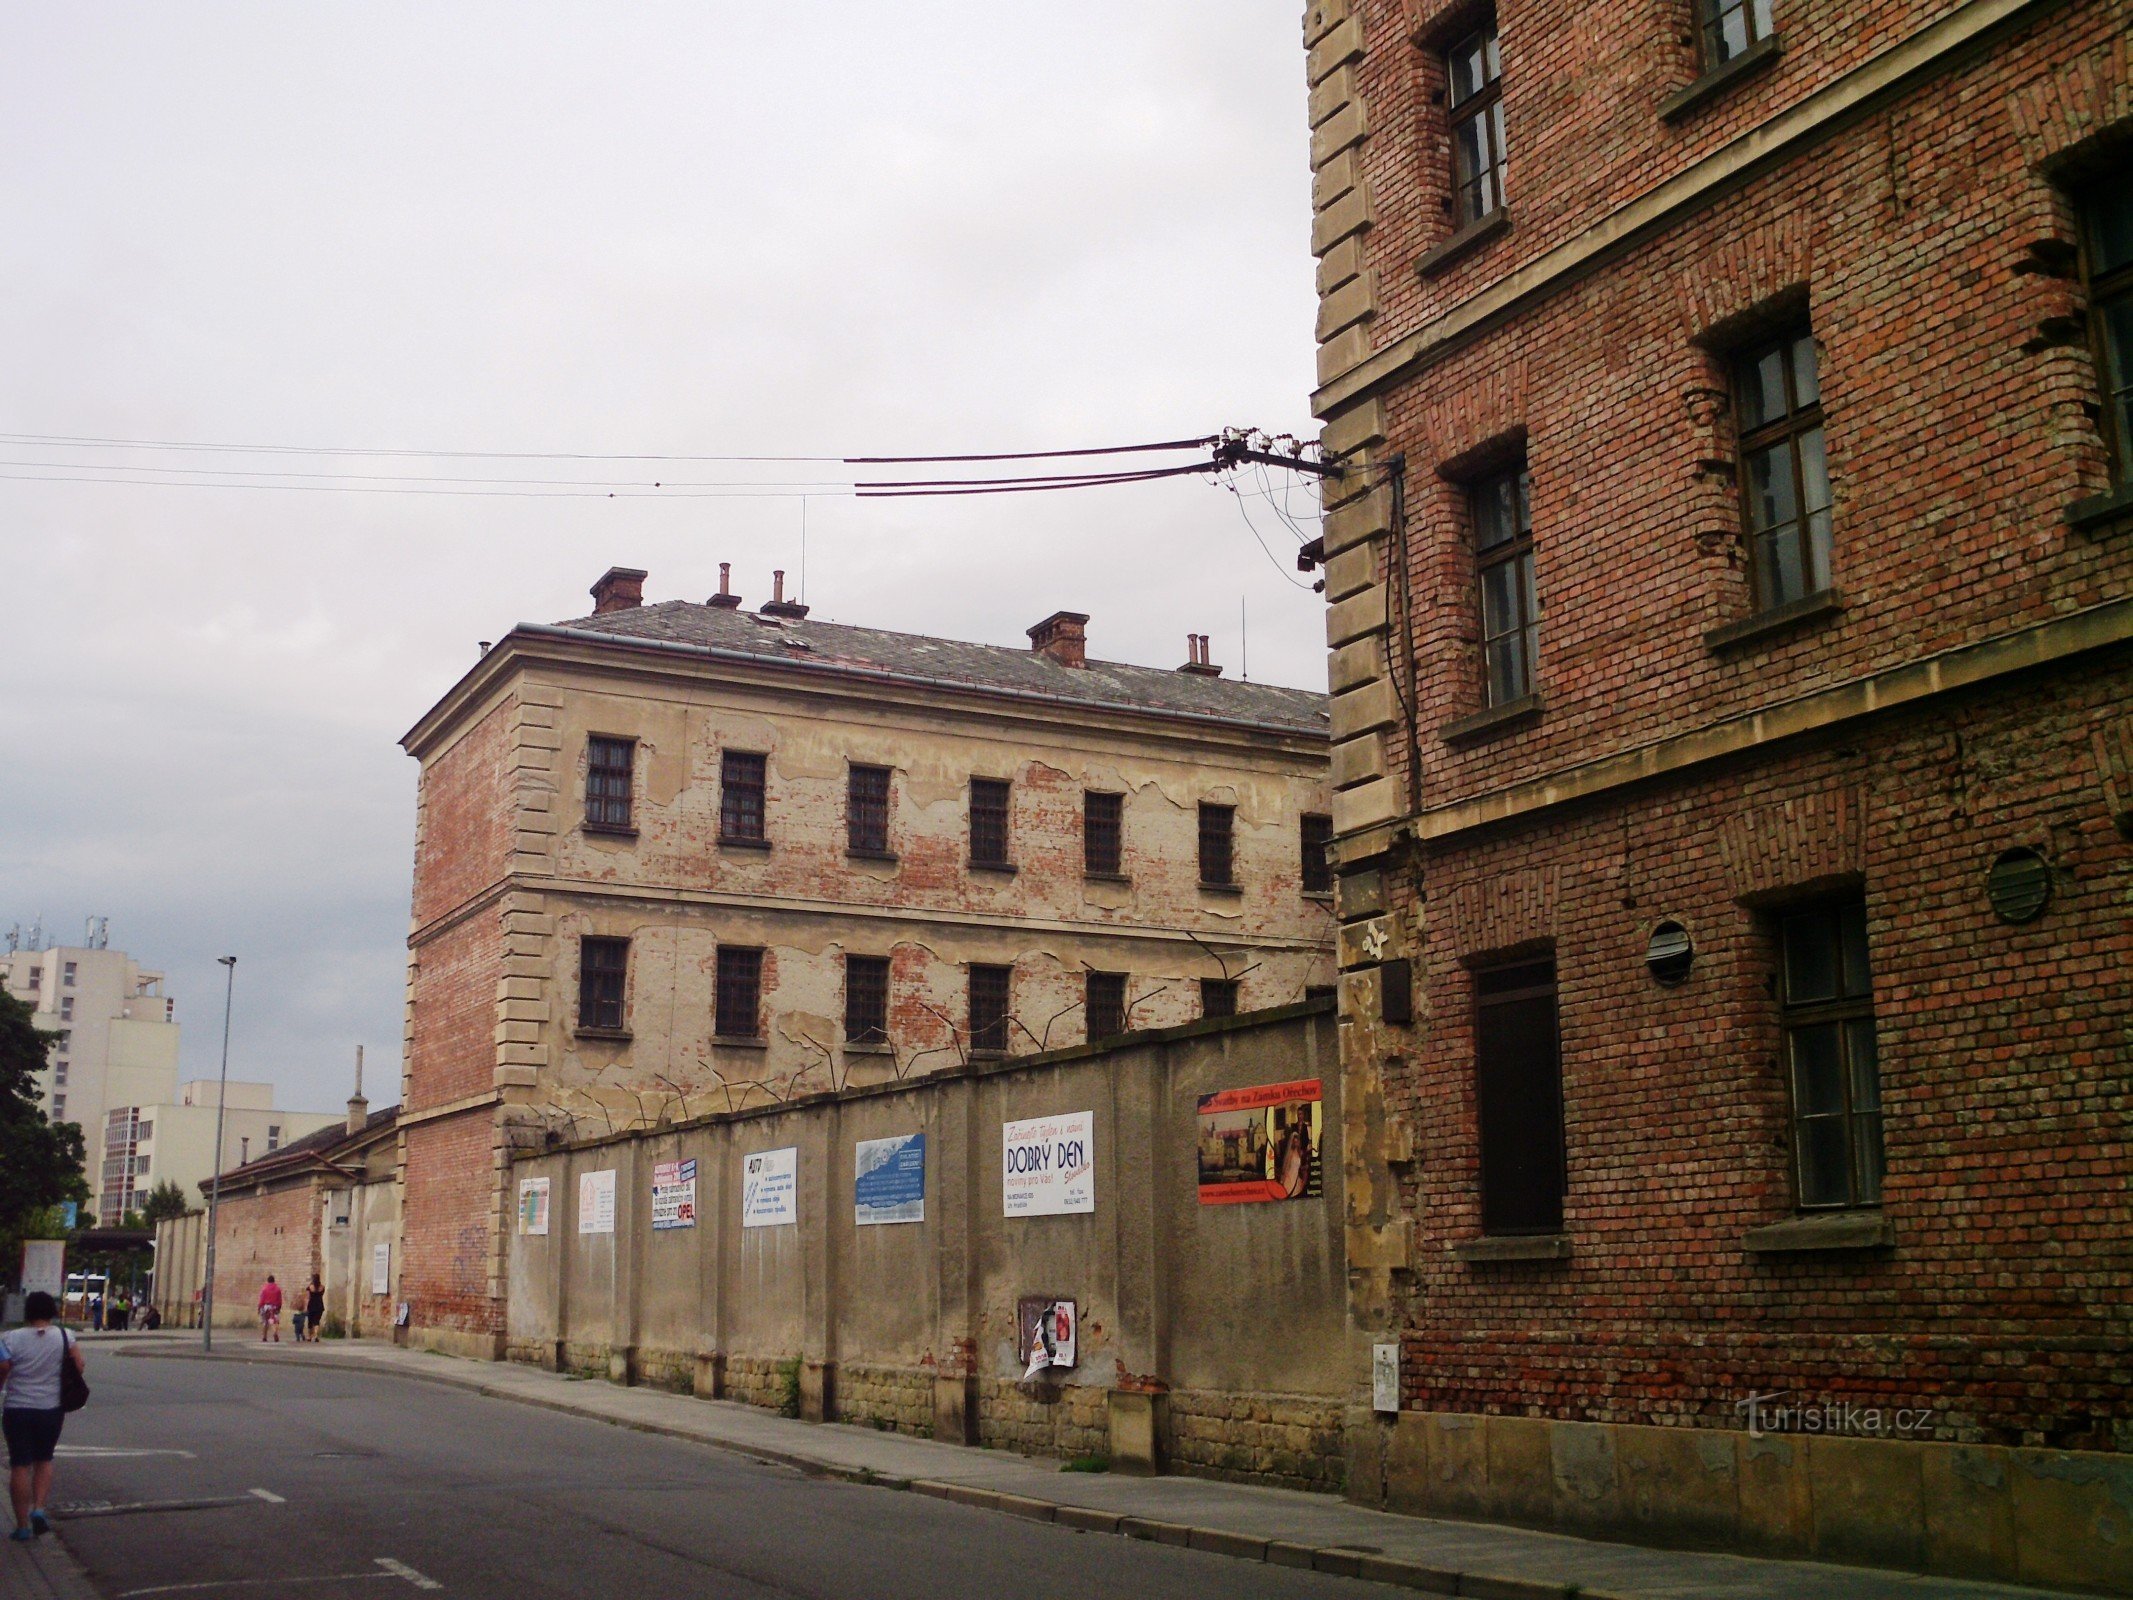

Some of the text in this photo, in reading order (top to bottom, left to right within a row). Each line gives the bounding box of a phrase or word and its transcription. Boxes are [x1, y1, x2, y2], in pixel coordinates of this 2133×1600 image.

[1241, 1095, 1250, 1104] na
[1007, 1138, 1084, 1174] DOBRÝ DEN
[677, 1203, 695, 1219] OPEL
